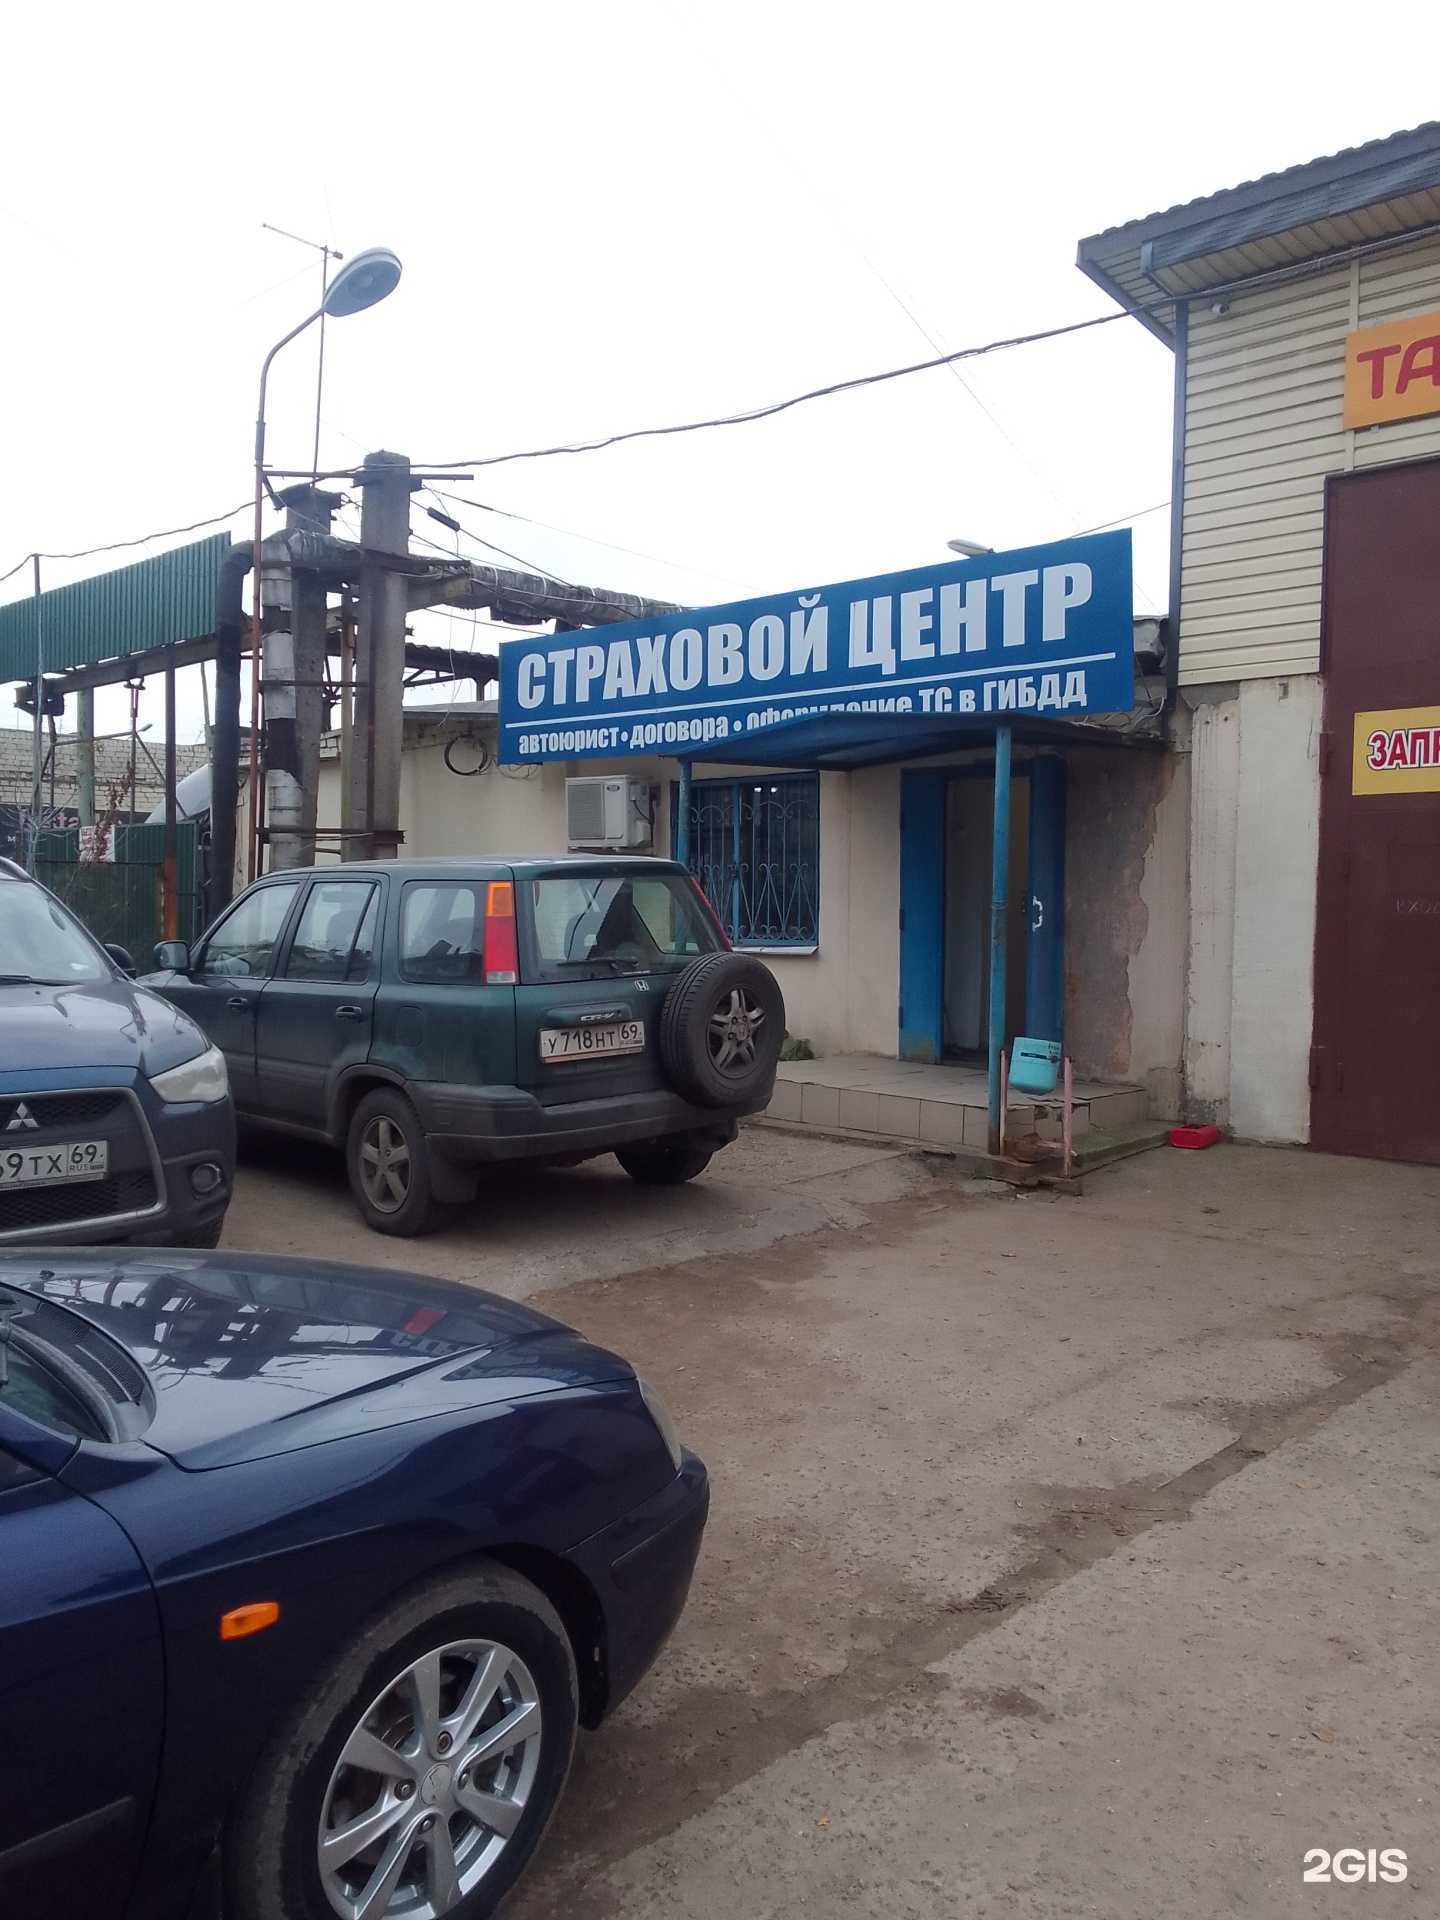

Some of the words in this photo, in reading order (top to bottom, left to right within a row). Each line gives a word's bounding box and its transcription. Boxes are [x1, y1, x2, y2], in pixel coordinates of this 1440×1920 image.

[517, 594, 829, 709] СТРАХОВОЙ
[849, 562, 1092, 675] ЦЕНТР
[519, 727, 620, 754] автоюрист
[629, 716, 728, 749] договора
[919, 686, 952, 712] ТС
[959, 689, 976, 712] в
[983, 670, 1088, 712] ГИБДД
